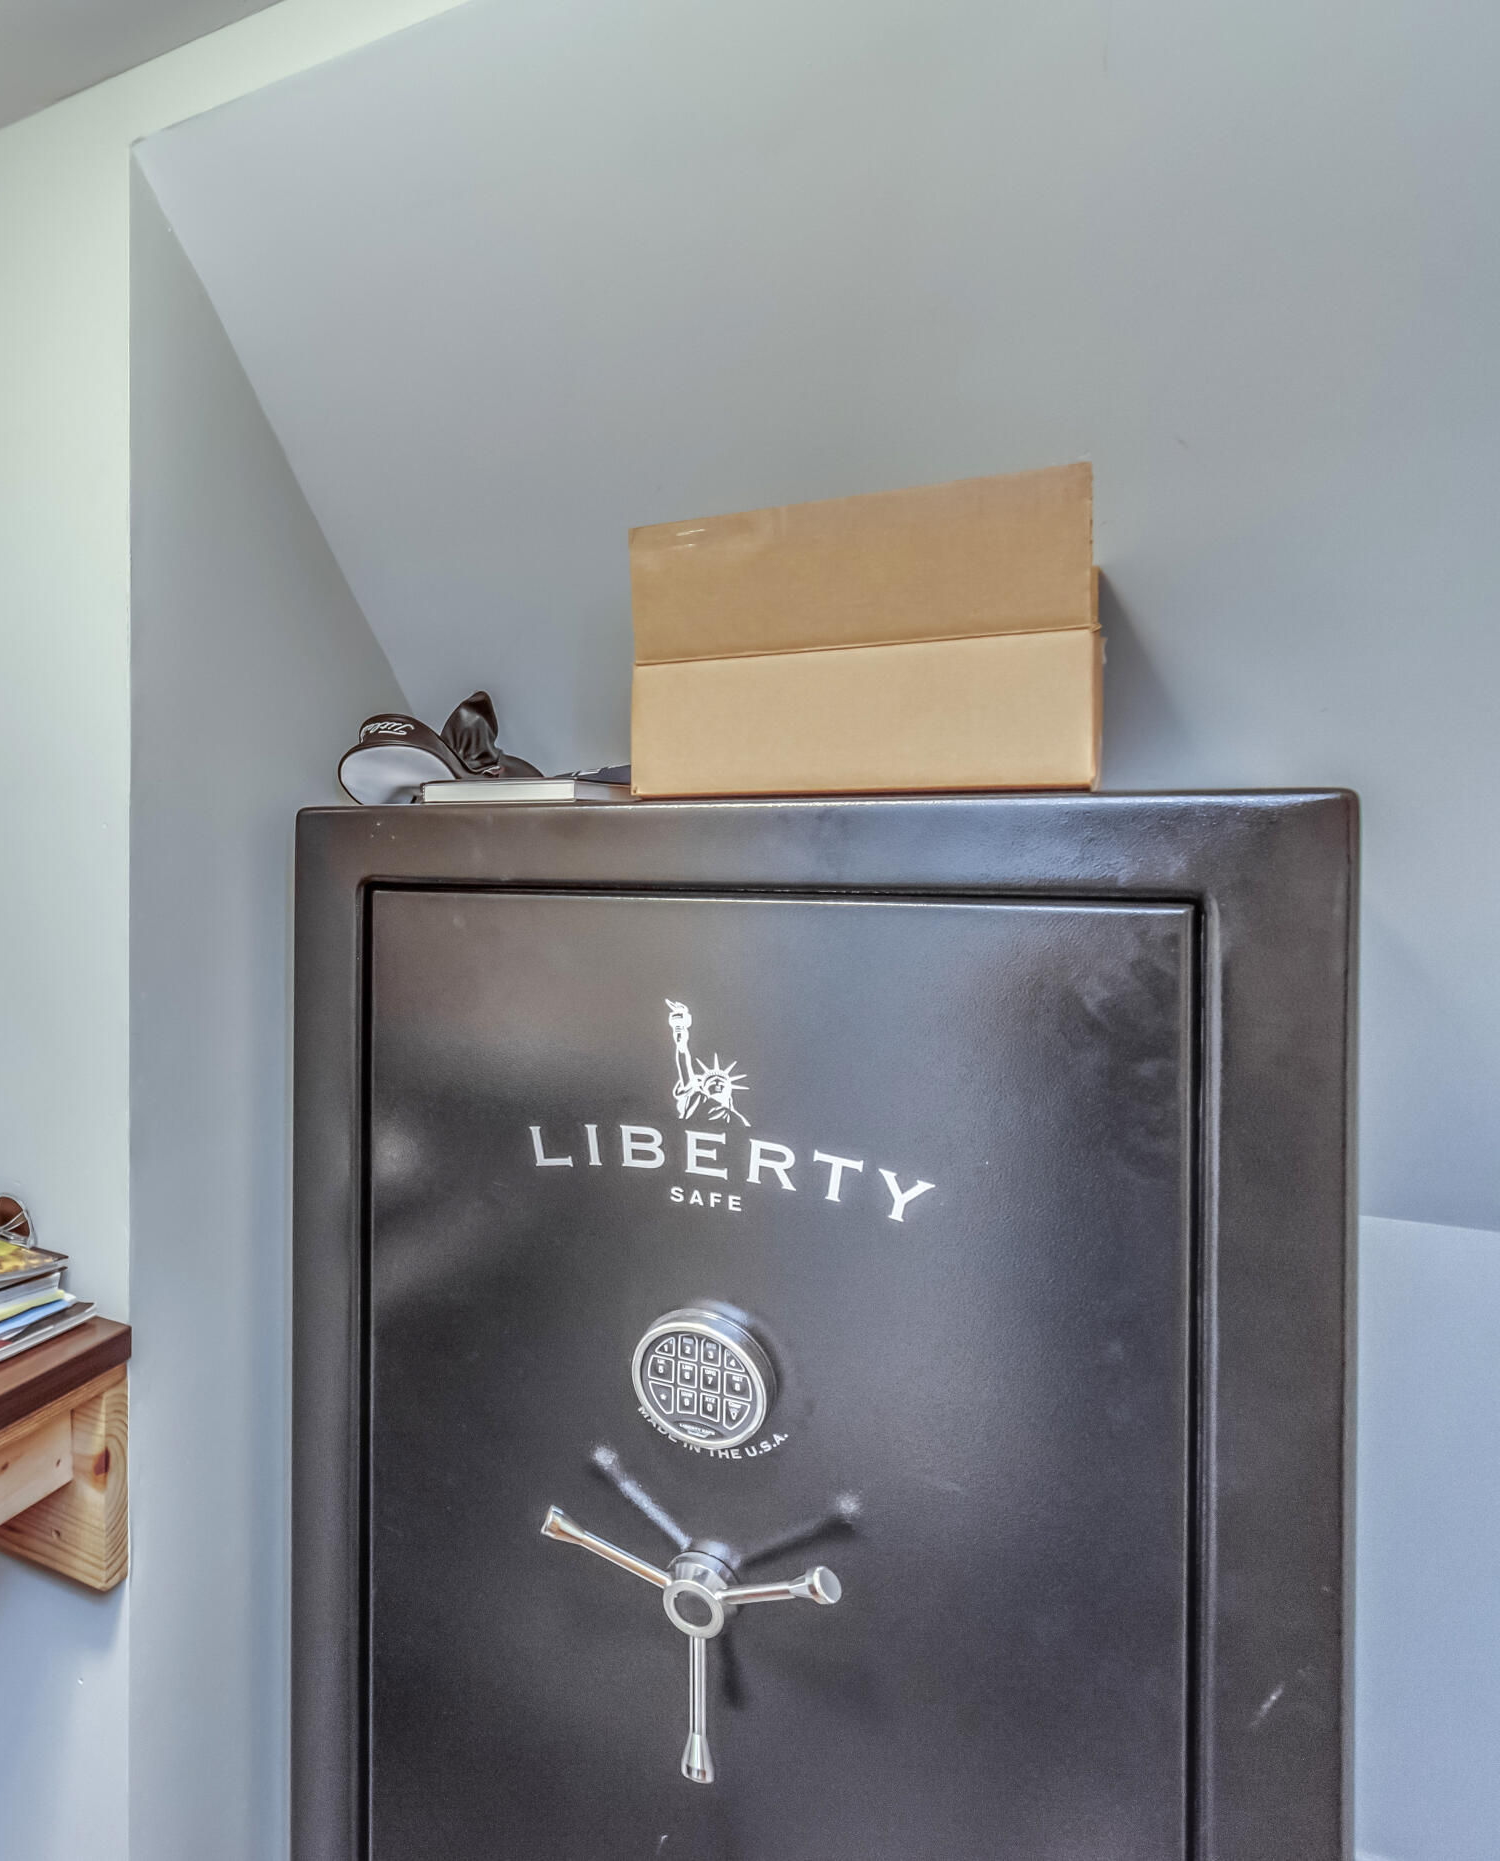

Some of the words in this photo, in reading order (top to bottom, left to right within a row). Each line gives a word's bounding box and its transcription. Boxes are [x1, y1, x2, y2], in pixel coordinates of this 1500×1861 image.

[529, 1123, 936, 1222] LIBERTY
[670, 1186, 742, 1212] SAFE
[709, 1448, 742, 1460] THE
[744, 1433, 789, 1458] U.S.A.
